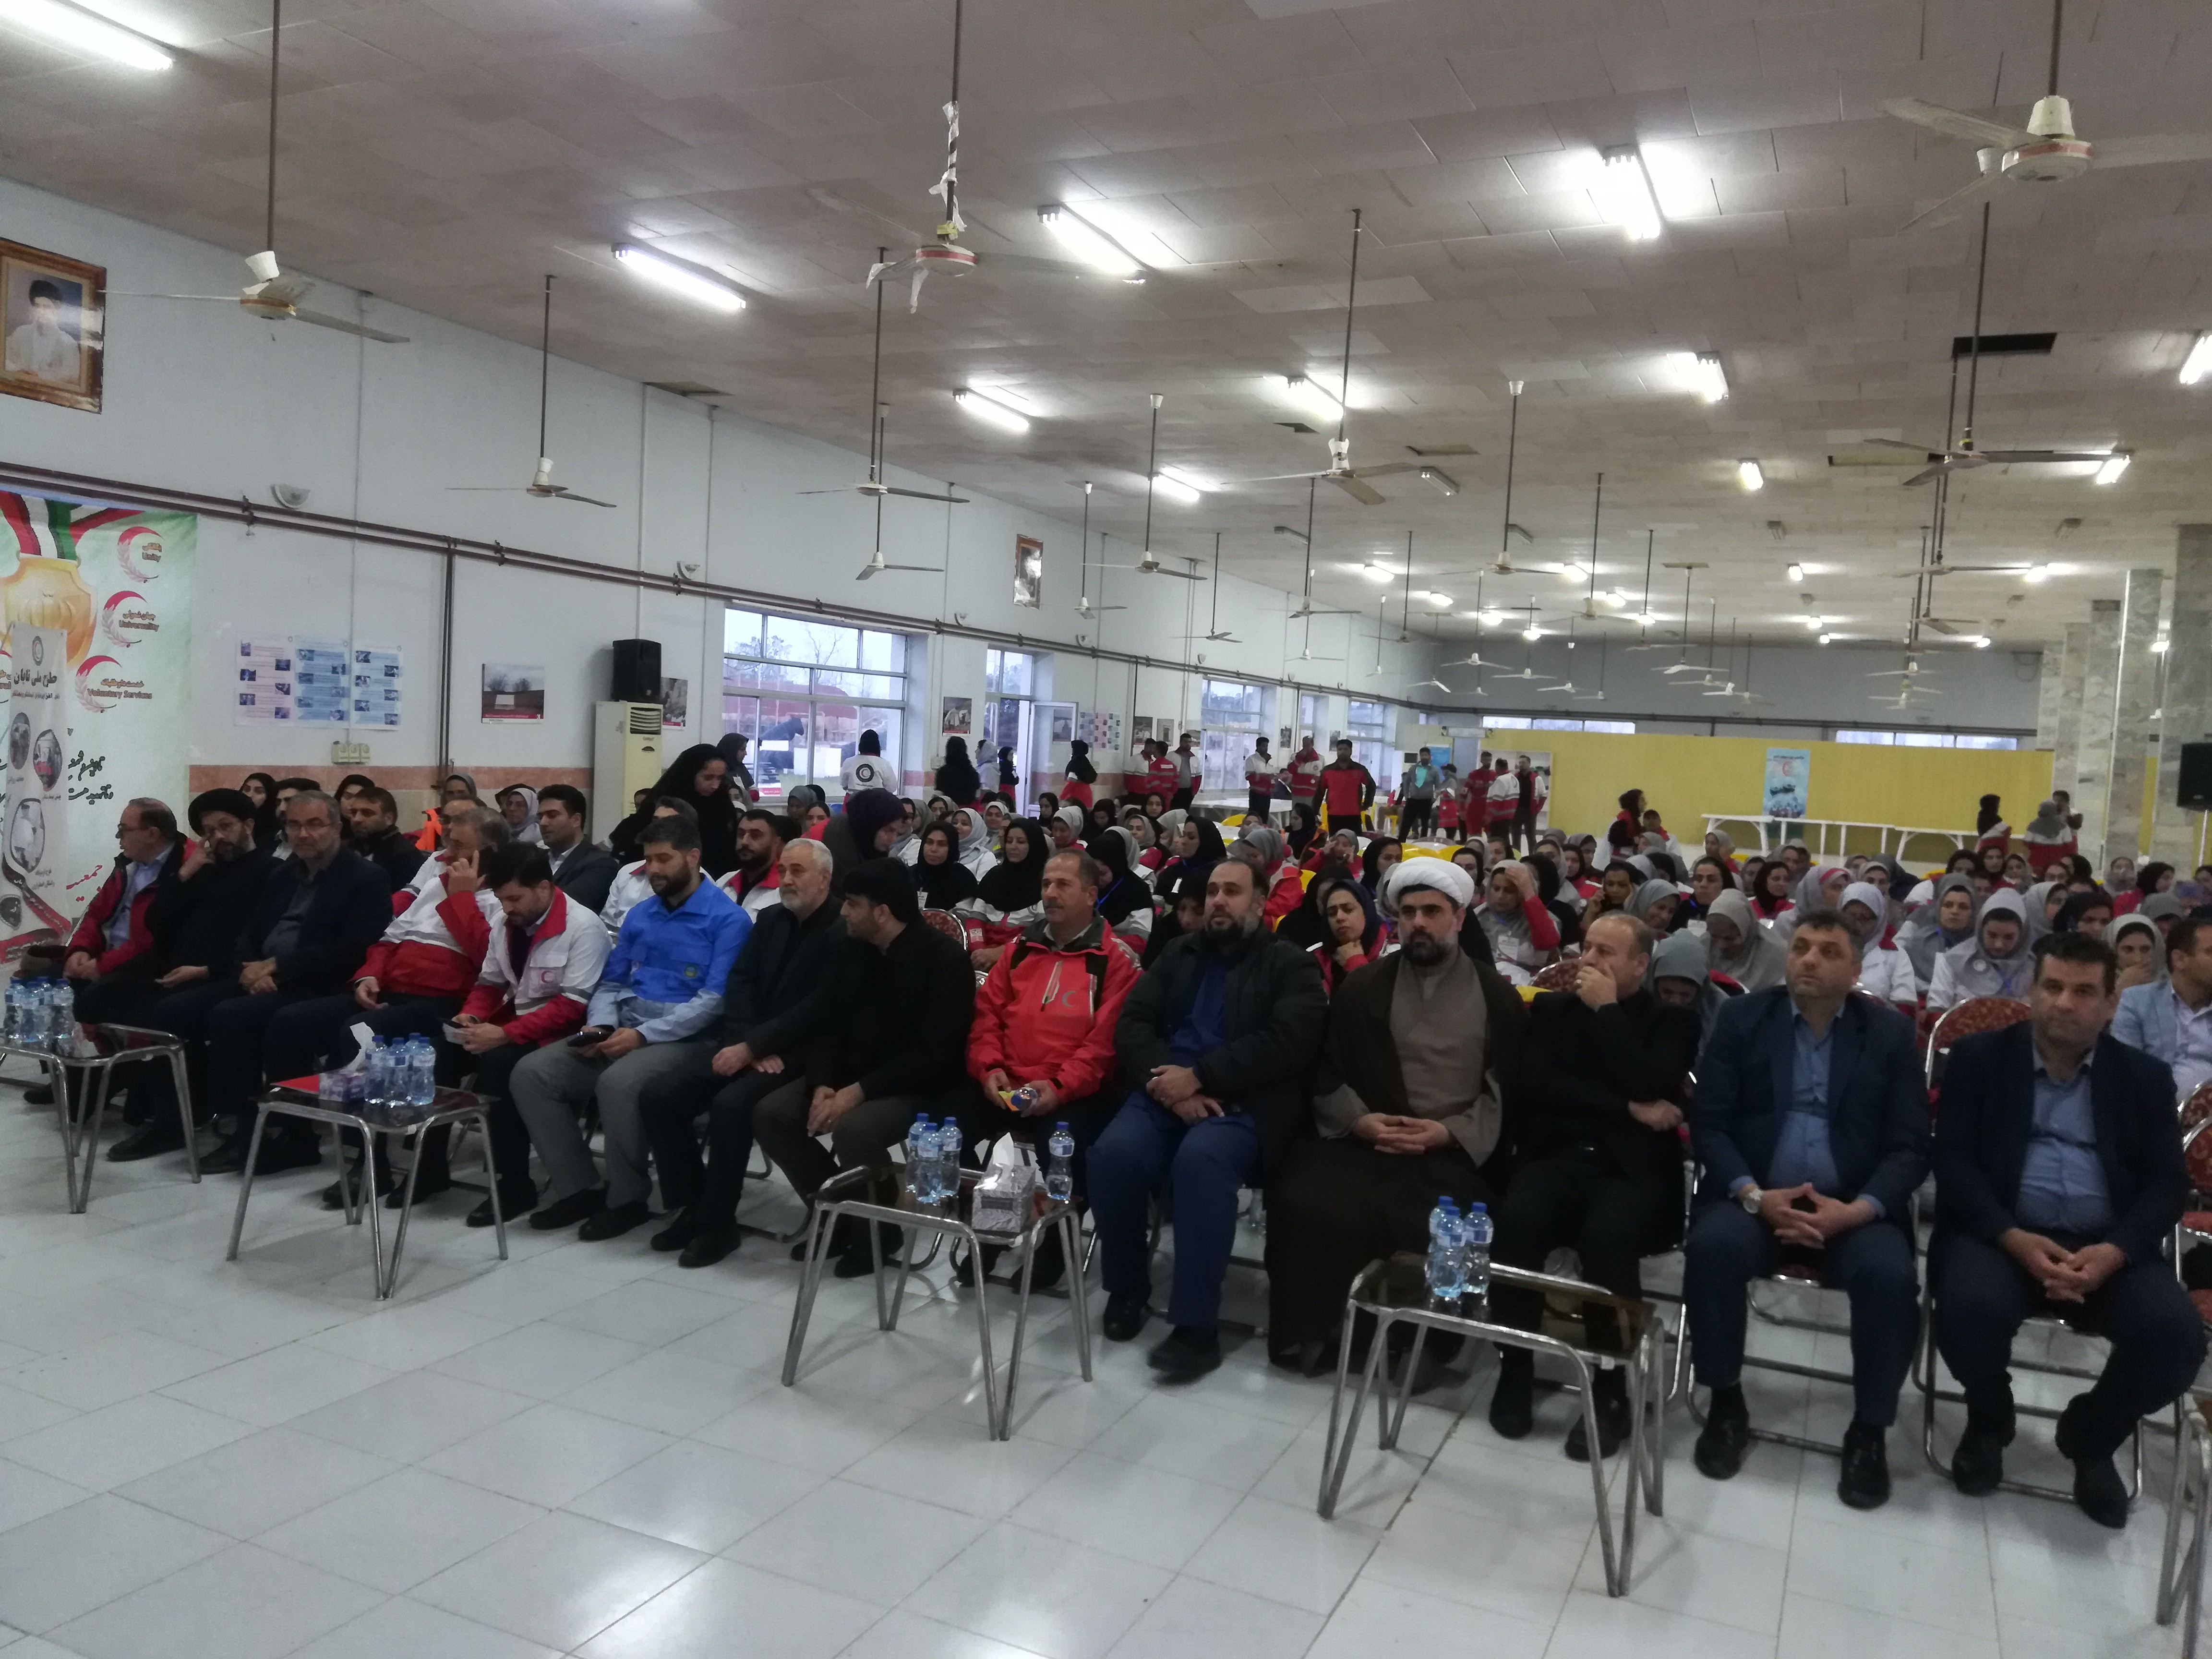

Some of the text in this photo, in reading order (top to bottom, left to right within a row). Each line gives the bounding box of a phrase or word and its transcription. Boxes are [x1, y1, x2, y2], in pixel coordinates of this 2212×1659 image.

[31, 670, 41, 686] ملی
[43, 672, 57, 687] طرح
[87, 688, 152, 699] Voluntary Services
